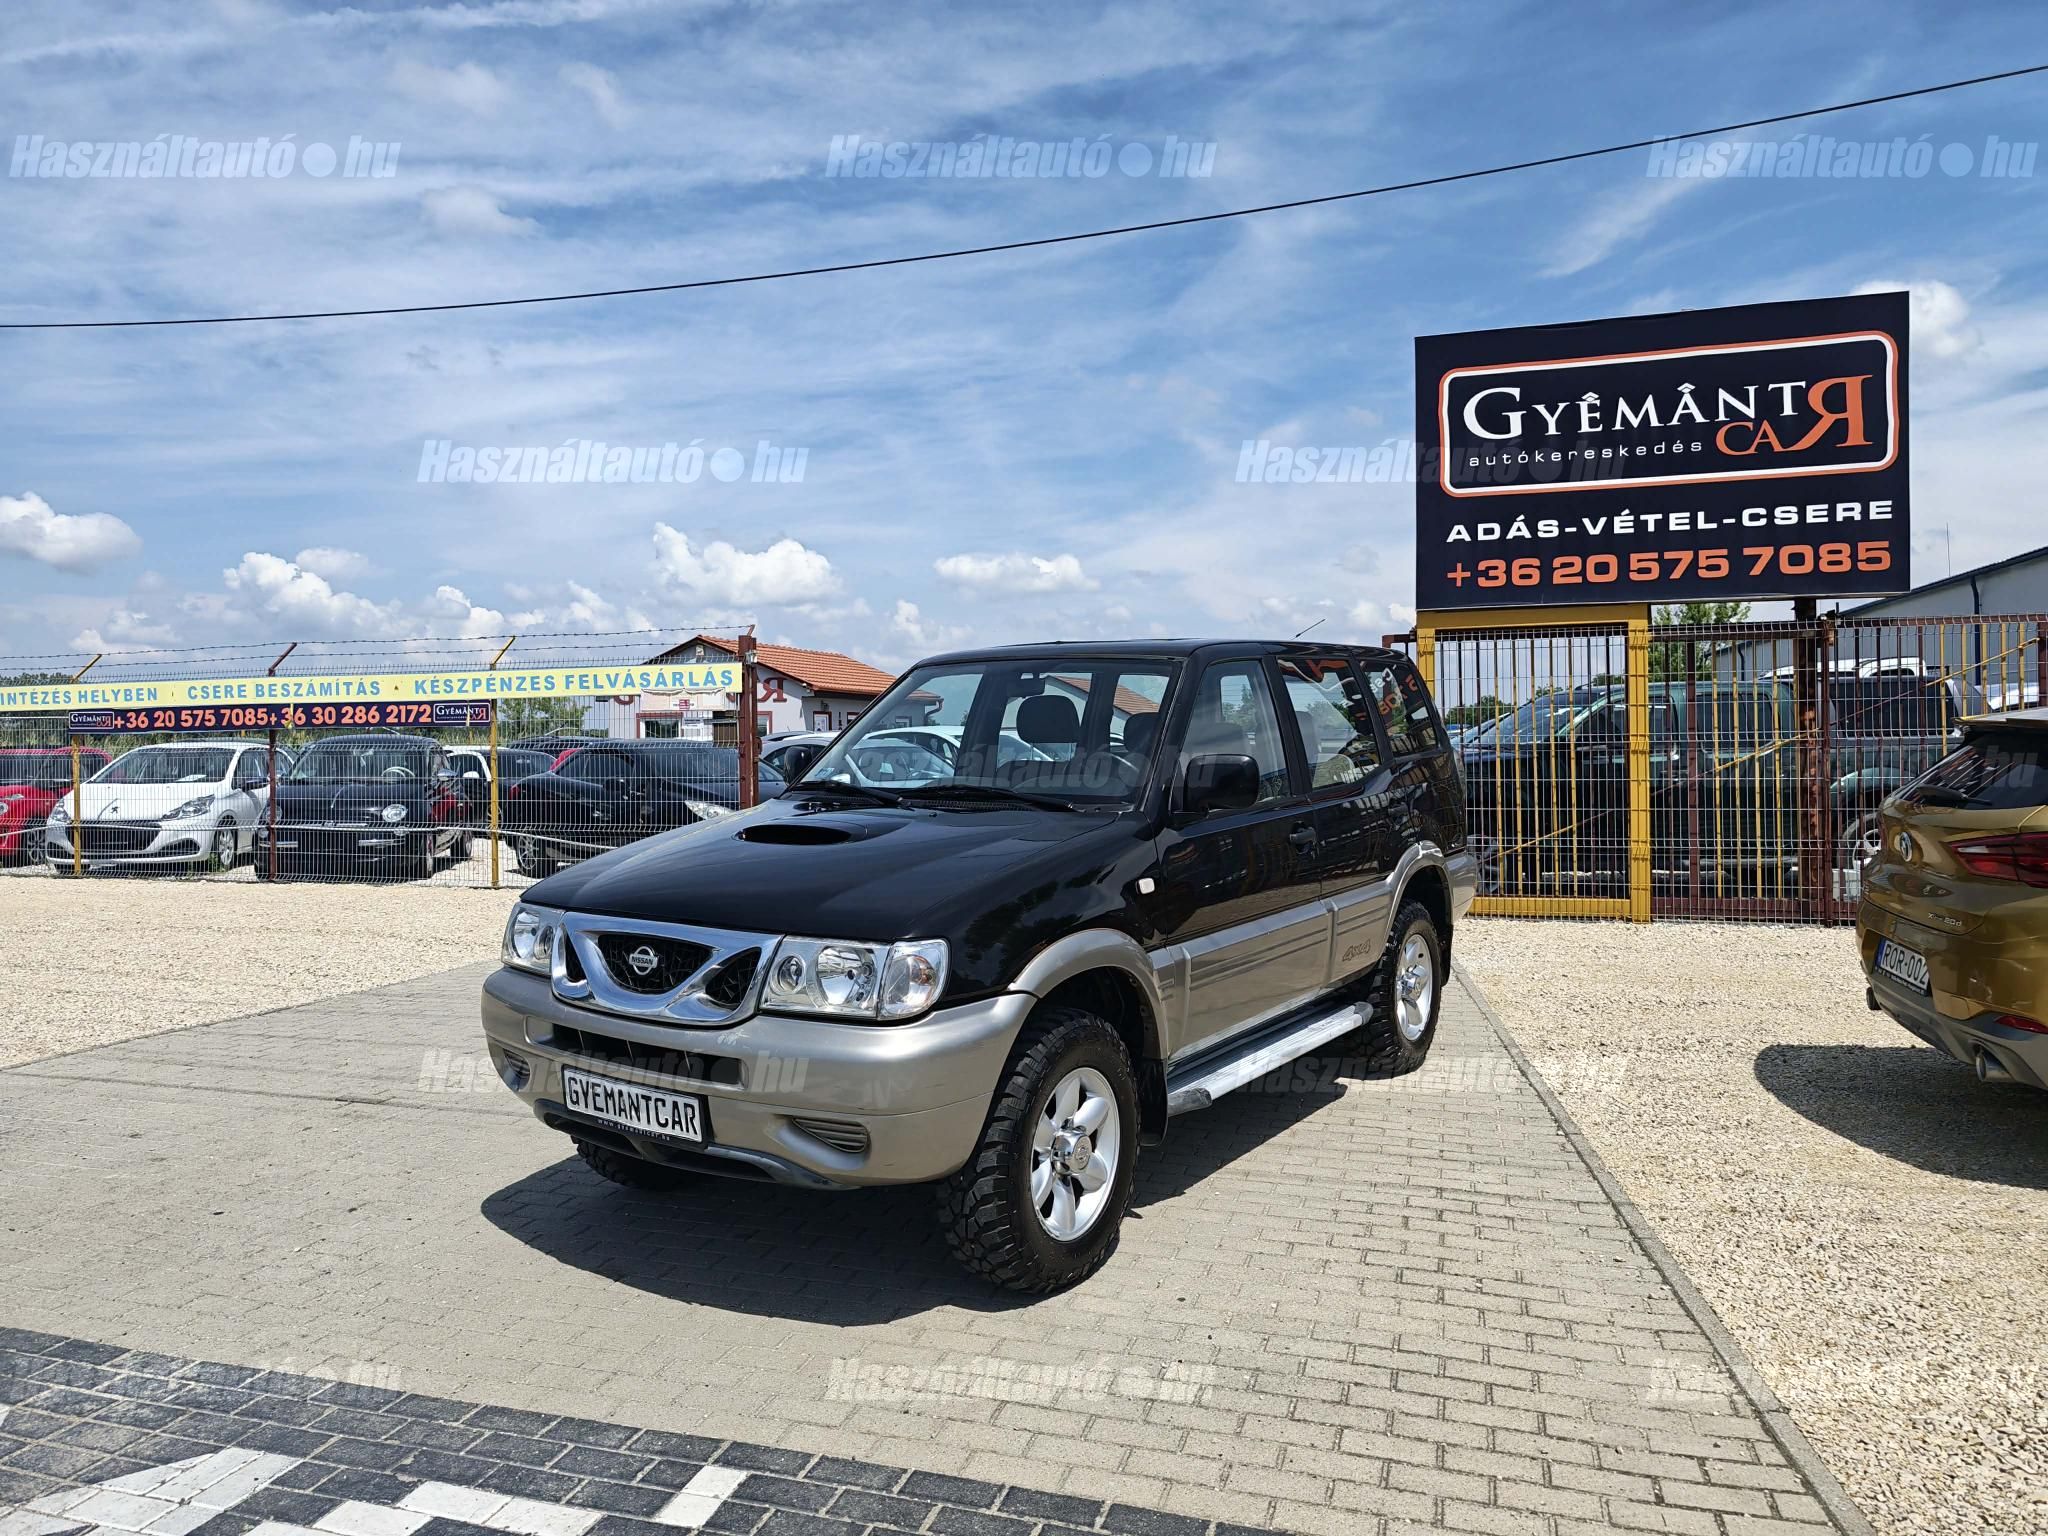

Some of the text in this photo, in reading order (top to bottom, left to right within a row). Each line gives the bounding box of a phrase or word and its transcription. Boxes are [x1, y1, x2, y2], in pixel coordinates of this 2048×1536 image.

[1469, 440, 1703, 467] autókereskedés
[1446, 500, 1893, 543] ADÁS-VÉTEL-CSERE
[1447, 541, 1892, 588] +36 20 575 7085
[78, 687, 158, 703] HELYBEN
[187, 684, 248, 700] CSERE
[255, 678, 381, 698] BESZÁMÍTÁS
[414, 674, 556, 695] KÉSZPÉNZES
[565, 667, 733, 690] FELVÁSÁRLÁS
[115, 711, 149, 729] +36
[153, 710, 175, 728] 20
[180, 709, 216, 728] 575
[220, 707, 268, 727] 7085
[311, 706, 336, 725] 30
[341, 705, 380, 725] 286
[386, 704, 432, 723] 2172
[631, 956, 654, 966] NISSAN
[567, 1076, 698, 1136] GYEMANTCAR
